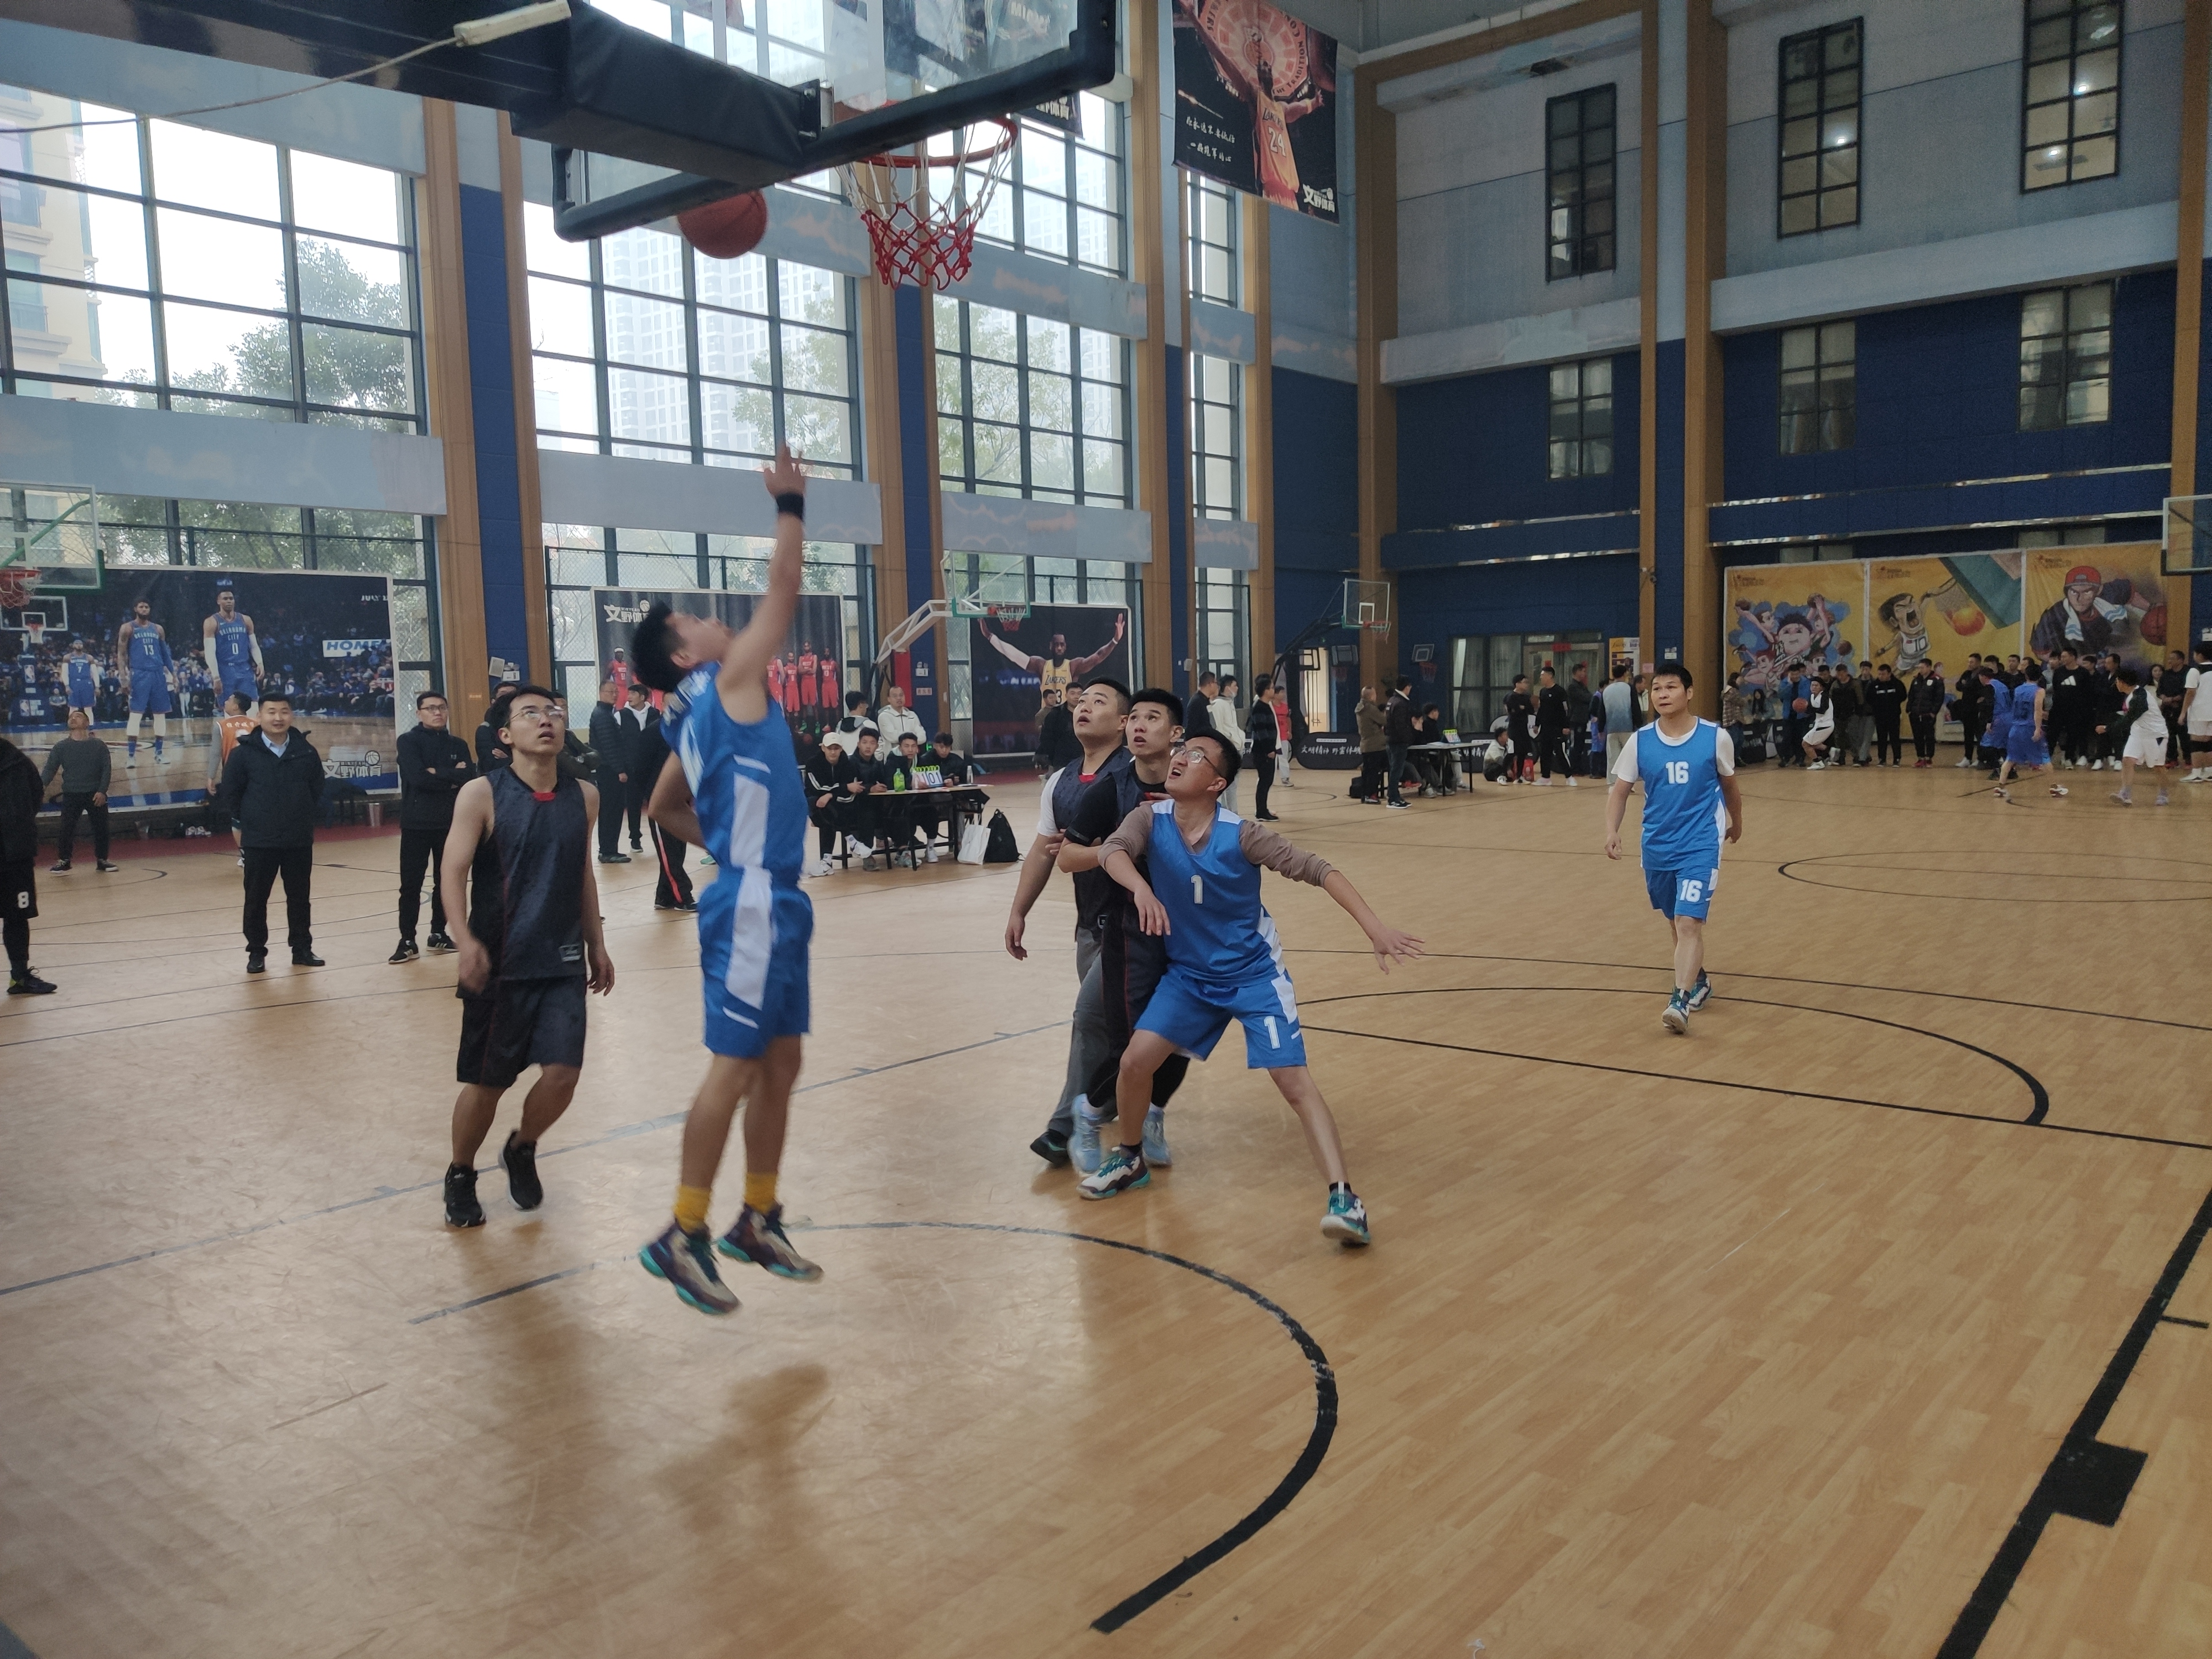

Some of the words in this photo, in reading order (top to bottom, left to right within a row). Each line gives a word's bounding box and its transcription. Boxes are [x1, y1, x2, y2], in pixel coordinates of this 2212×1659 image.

[1286, 40, 1306, 88] TRADITION
[1262, 107, 1284, 131] LAKERS
[1267, 125, 1286, 158] 24
[1302, 184, 1335, 213] 文野体育
[144, 644, 154, 656] 13
[1914, 636, 1928, 652] 10
[1045, 674, 1066, 686] LAKERS
[321, 759, 382, 779] 文野体育
[928, 771, 941, 784] 01
[1666, 761, 1689, 784] 16
[18, 891, 29, 909] 8
[1191, 874, 1203, 904] 1
[1679, 879, 1703, 903] 16
[1264, 1015, 1280, 1049] 1
